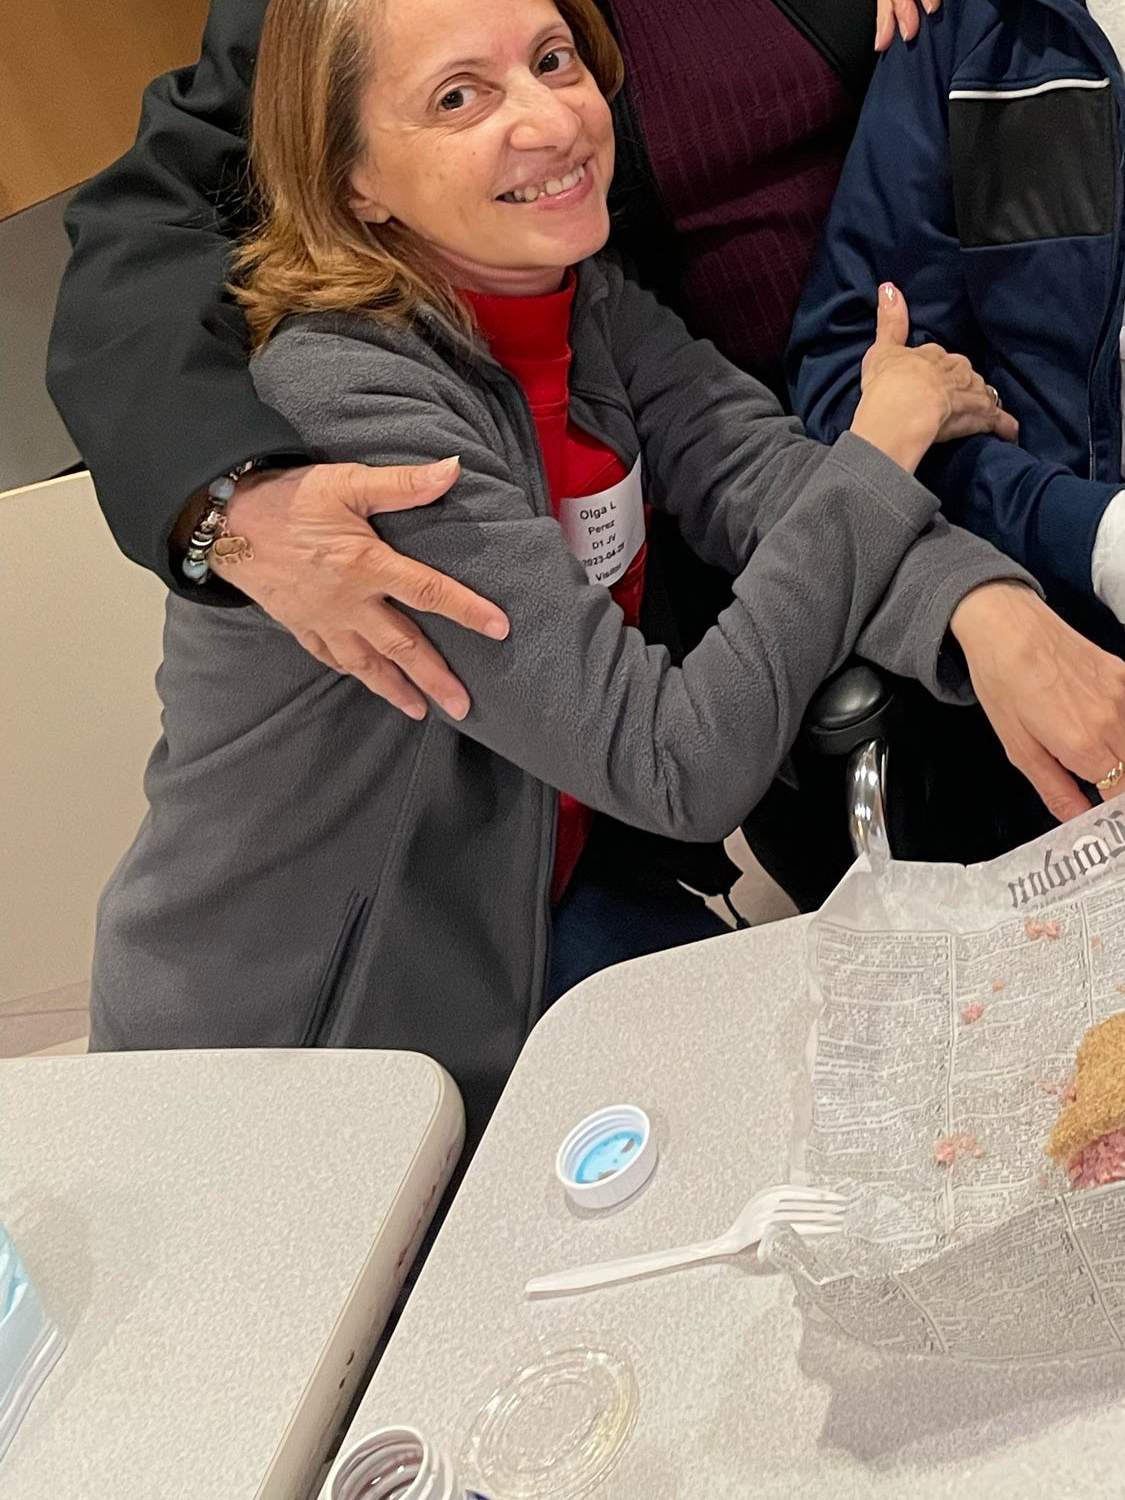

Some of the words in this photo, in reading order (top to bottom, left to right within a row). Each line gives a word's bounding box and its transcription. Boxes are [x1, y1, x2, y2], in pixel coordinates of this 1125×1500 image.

[579, 506, 607, 520] Olga
[610, 501, 617, 510] L
[588, 520, 615, 535] Perez
